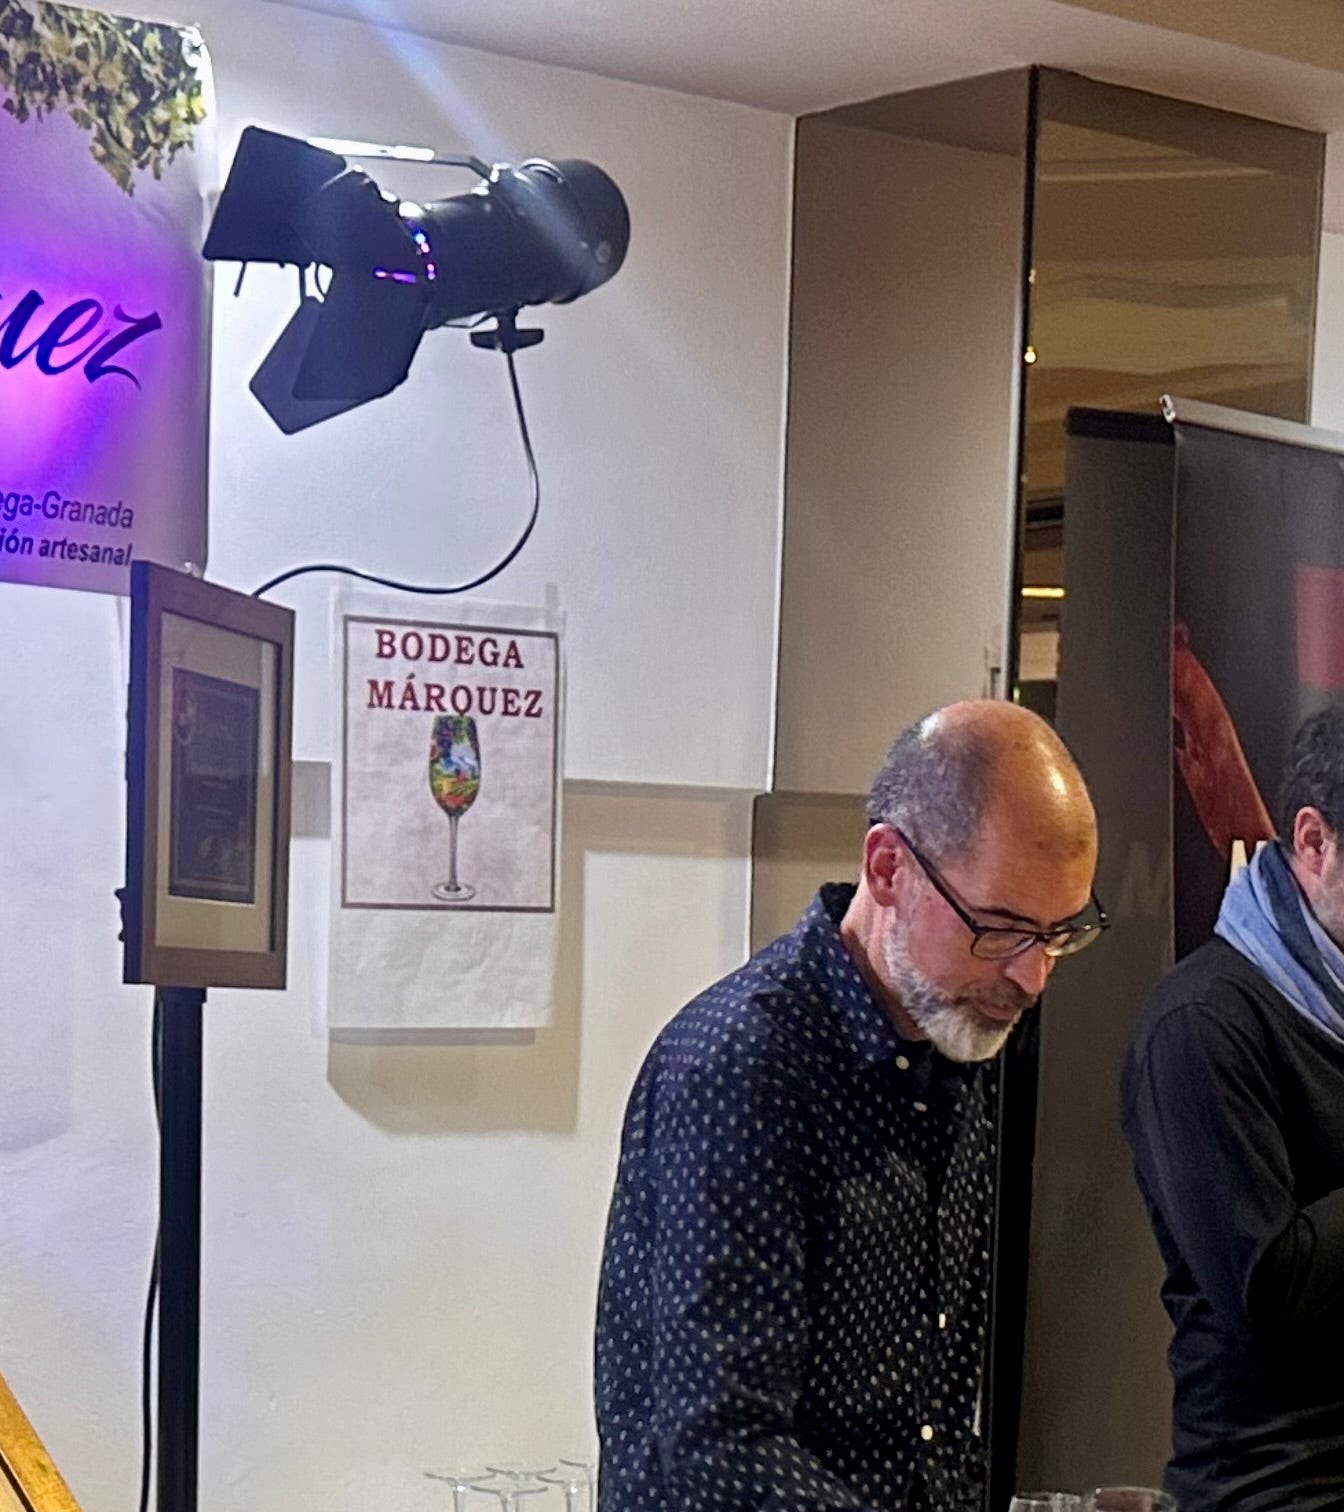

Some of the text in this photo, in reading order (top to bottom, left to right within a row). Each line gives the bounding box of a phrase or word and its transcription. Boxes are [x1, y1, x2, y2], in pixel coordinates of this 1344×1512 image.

[38, 536, 133, 567] artesanal
[374, 628, 525, 670] BODEGA
[366, 672, 544, 719] MÁRQUEZ
